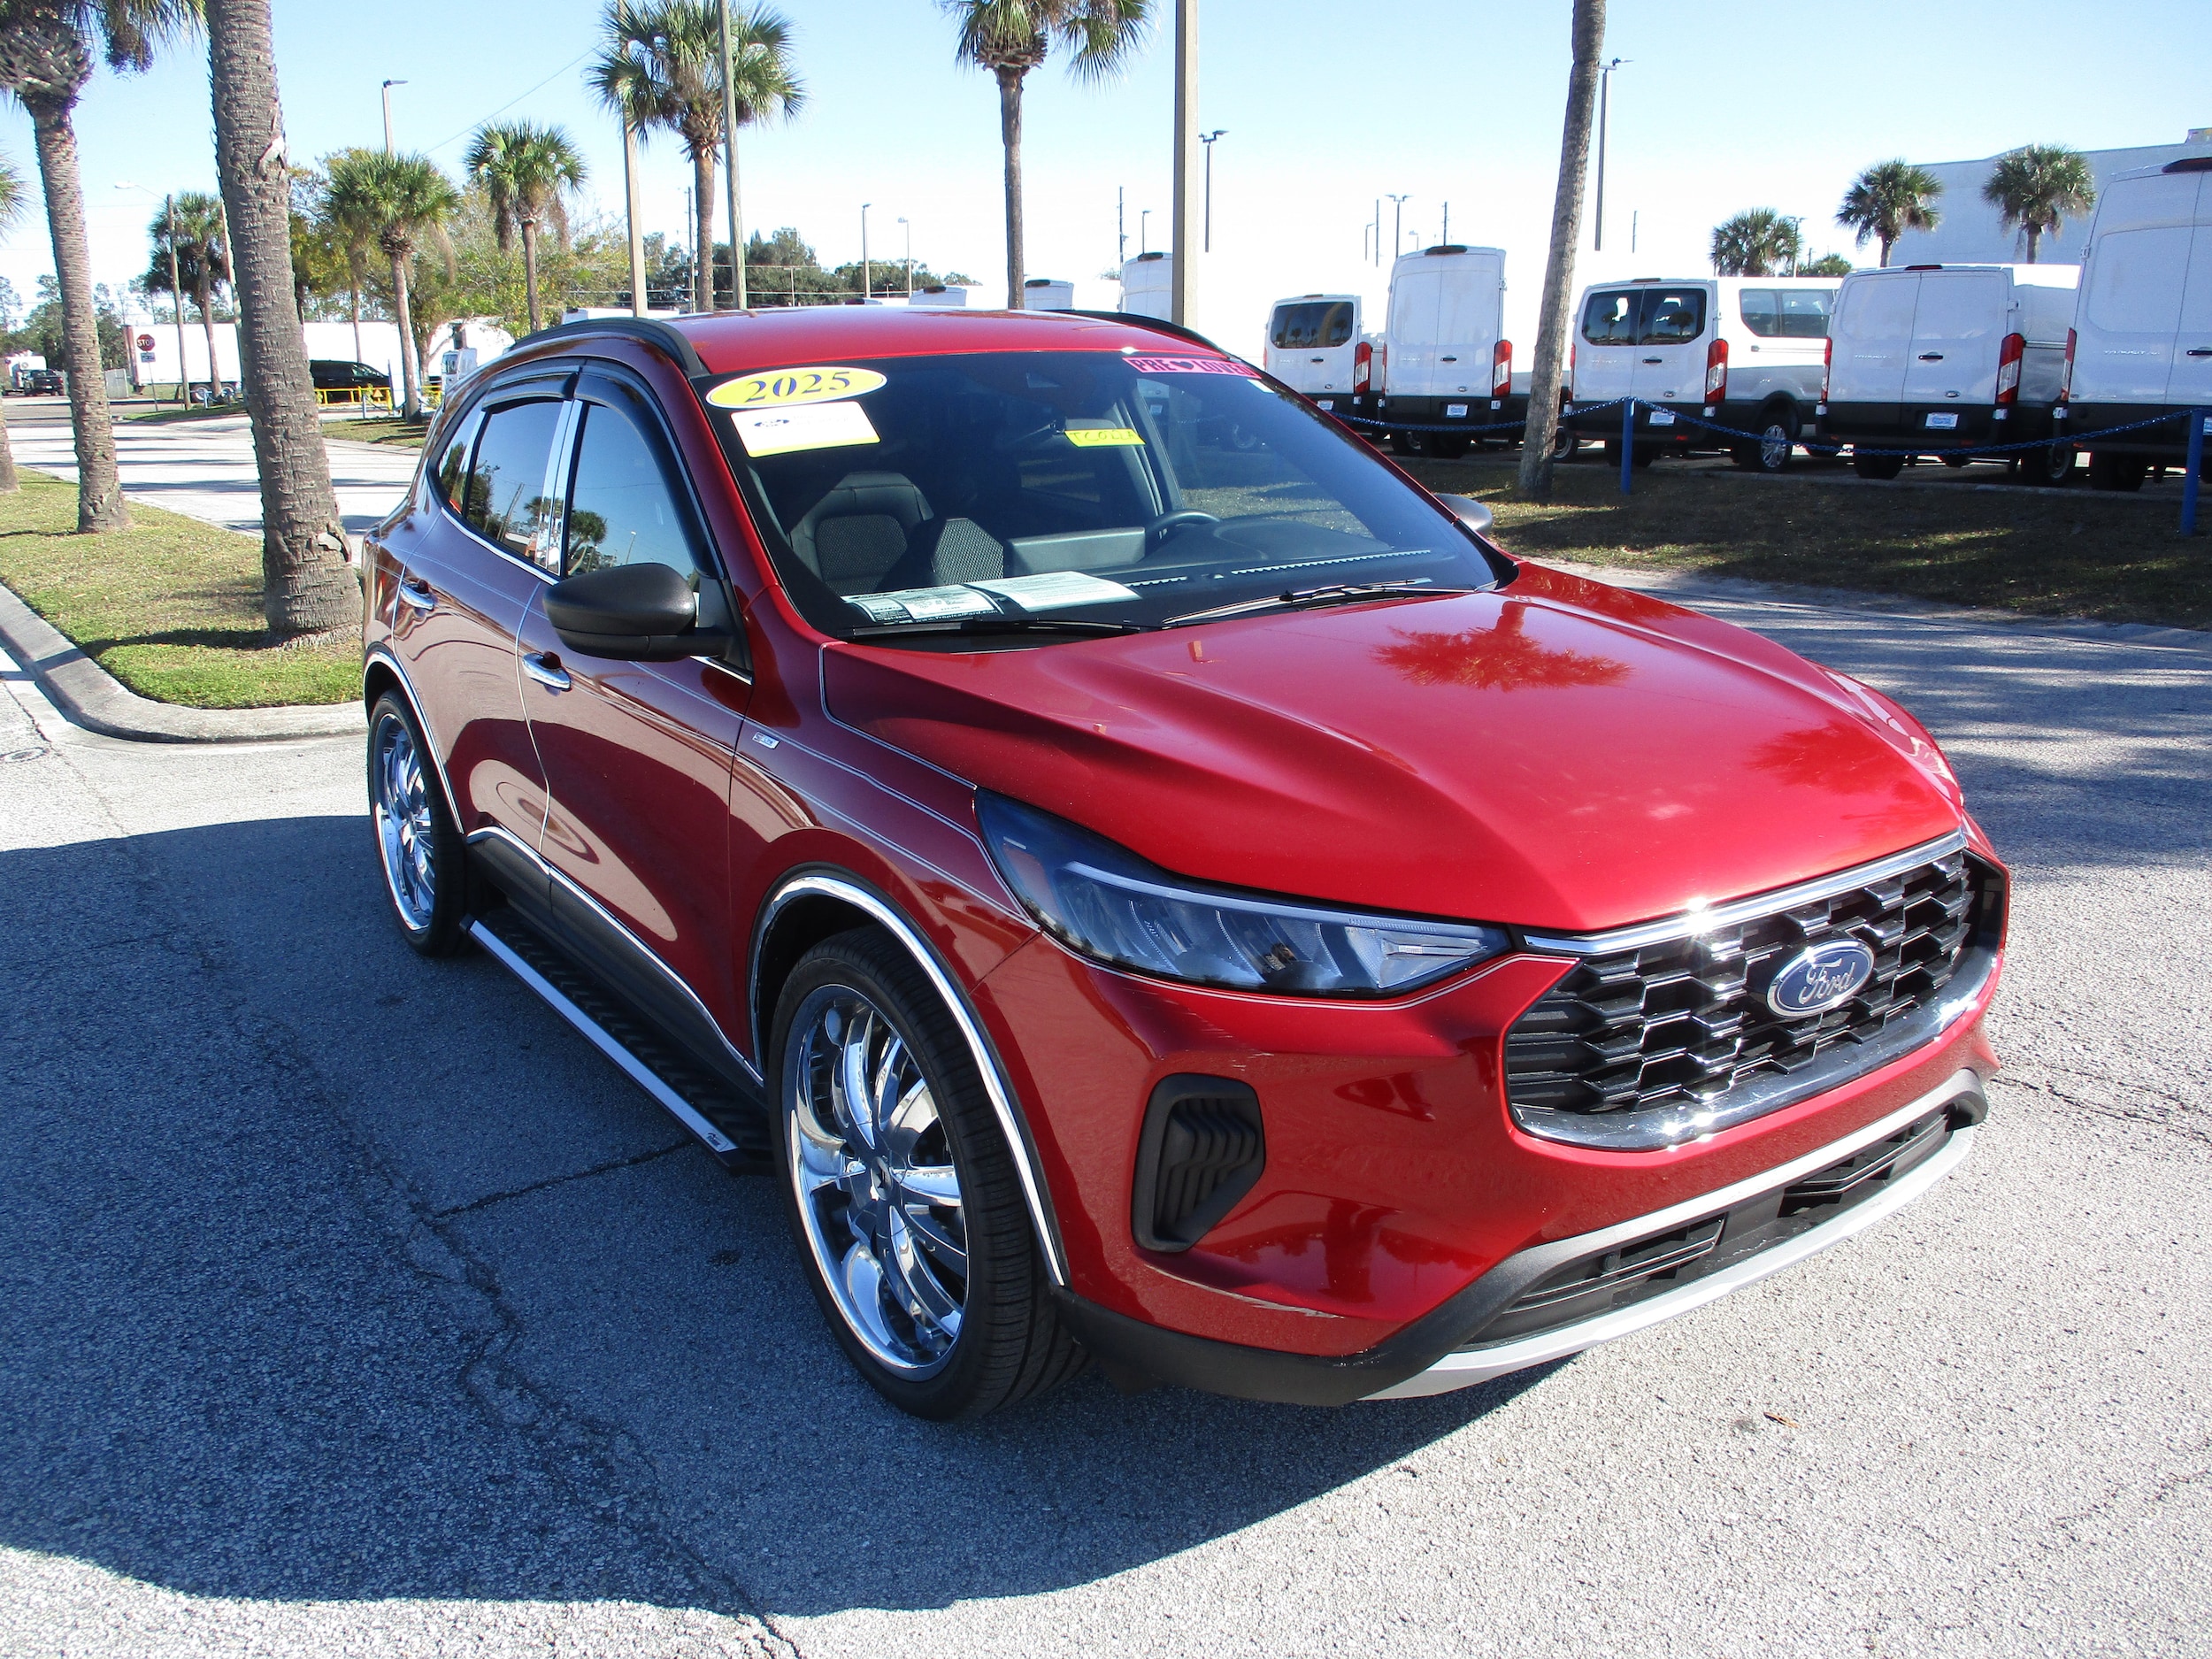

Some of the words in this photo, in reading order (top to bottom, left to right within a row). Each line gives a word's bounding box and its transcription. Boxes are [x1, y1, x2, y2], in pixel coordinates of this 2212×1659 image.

[1128, 359, 1178, 372] PRE
[1194, 360, 1260, 376] LOVED
[743, 371, 850, 403] 2025
[1798, 957, 1856, 1005] Ford
